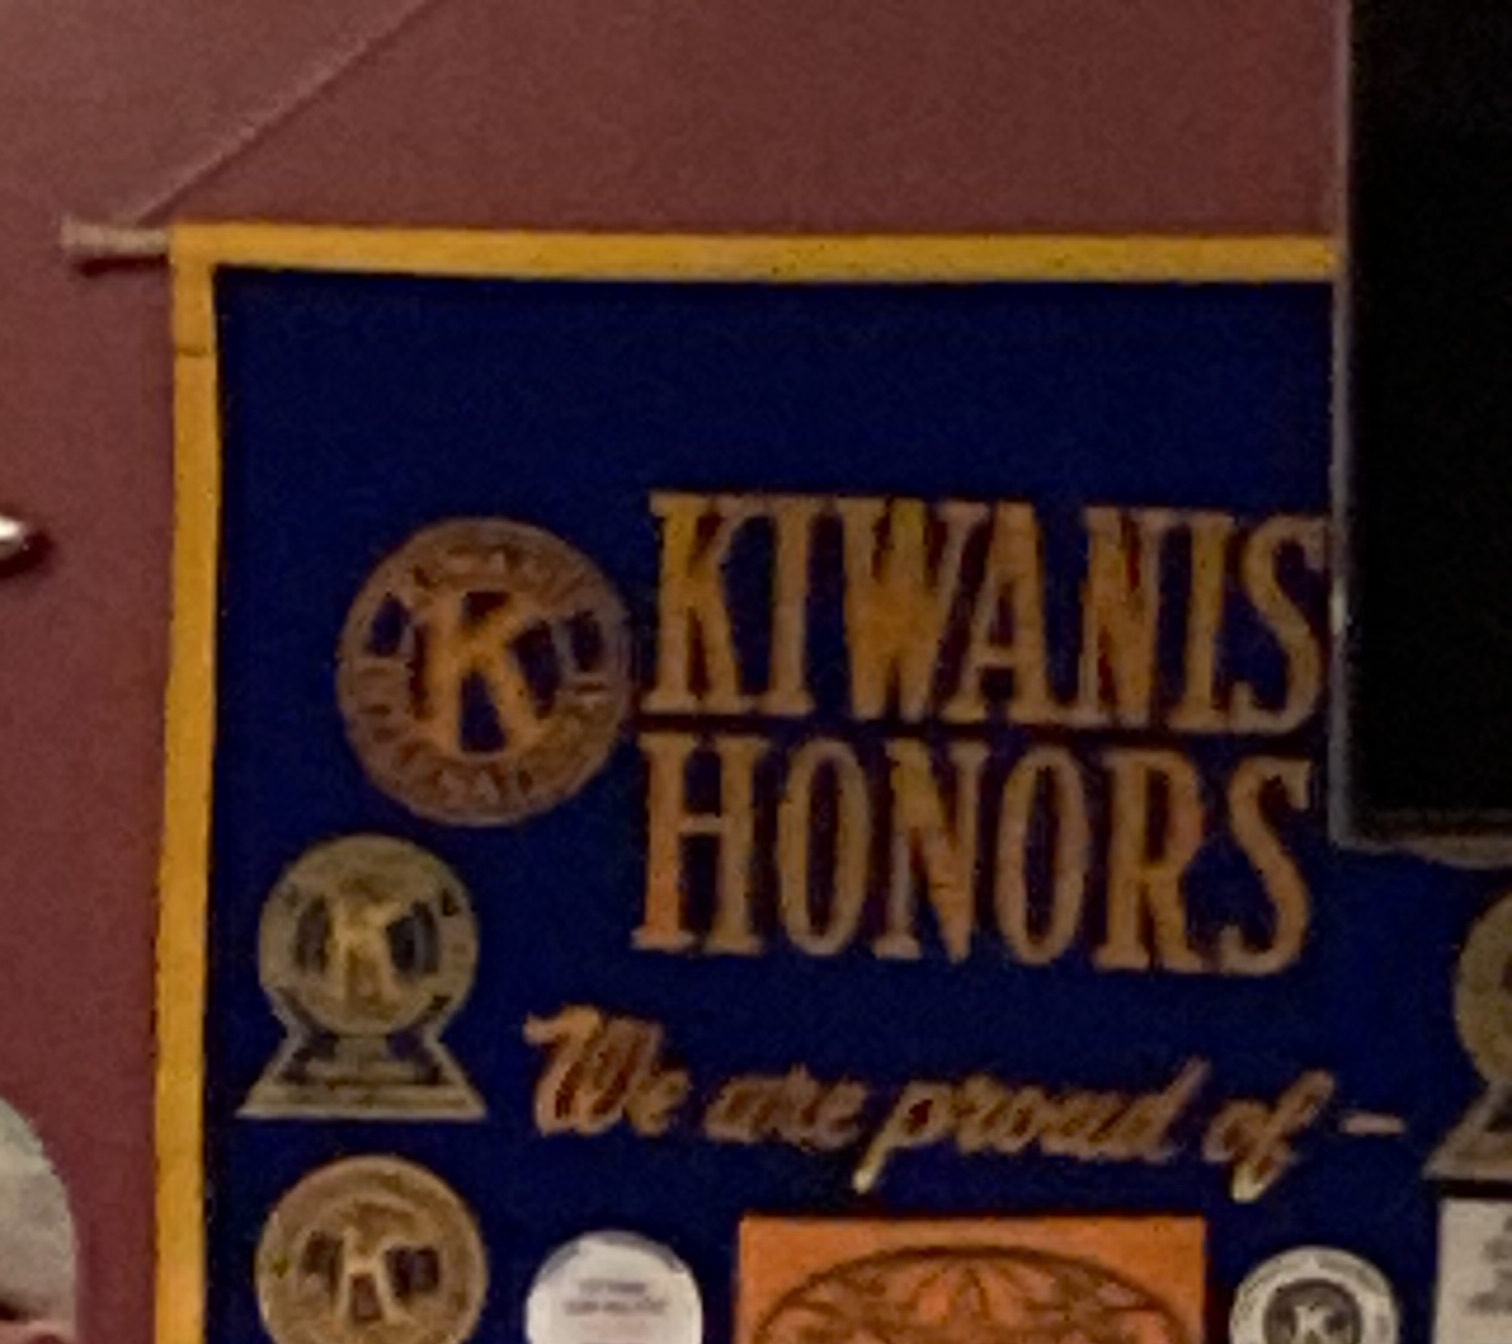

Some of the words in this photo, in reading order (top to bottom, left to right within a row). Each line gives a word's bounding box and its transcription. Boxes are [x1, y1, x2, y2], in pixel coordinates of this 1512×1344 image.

[641, 490, 1330, 736] KIWANIS
[632, 733, 1313, 977] HONORS
[524, 1004, 688, 1136] We
[702, 1064, 870, 1150] are
[851, 1057, 1211, 1195] proud
